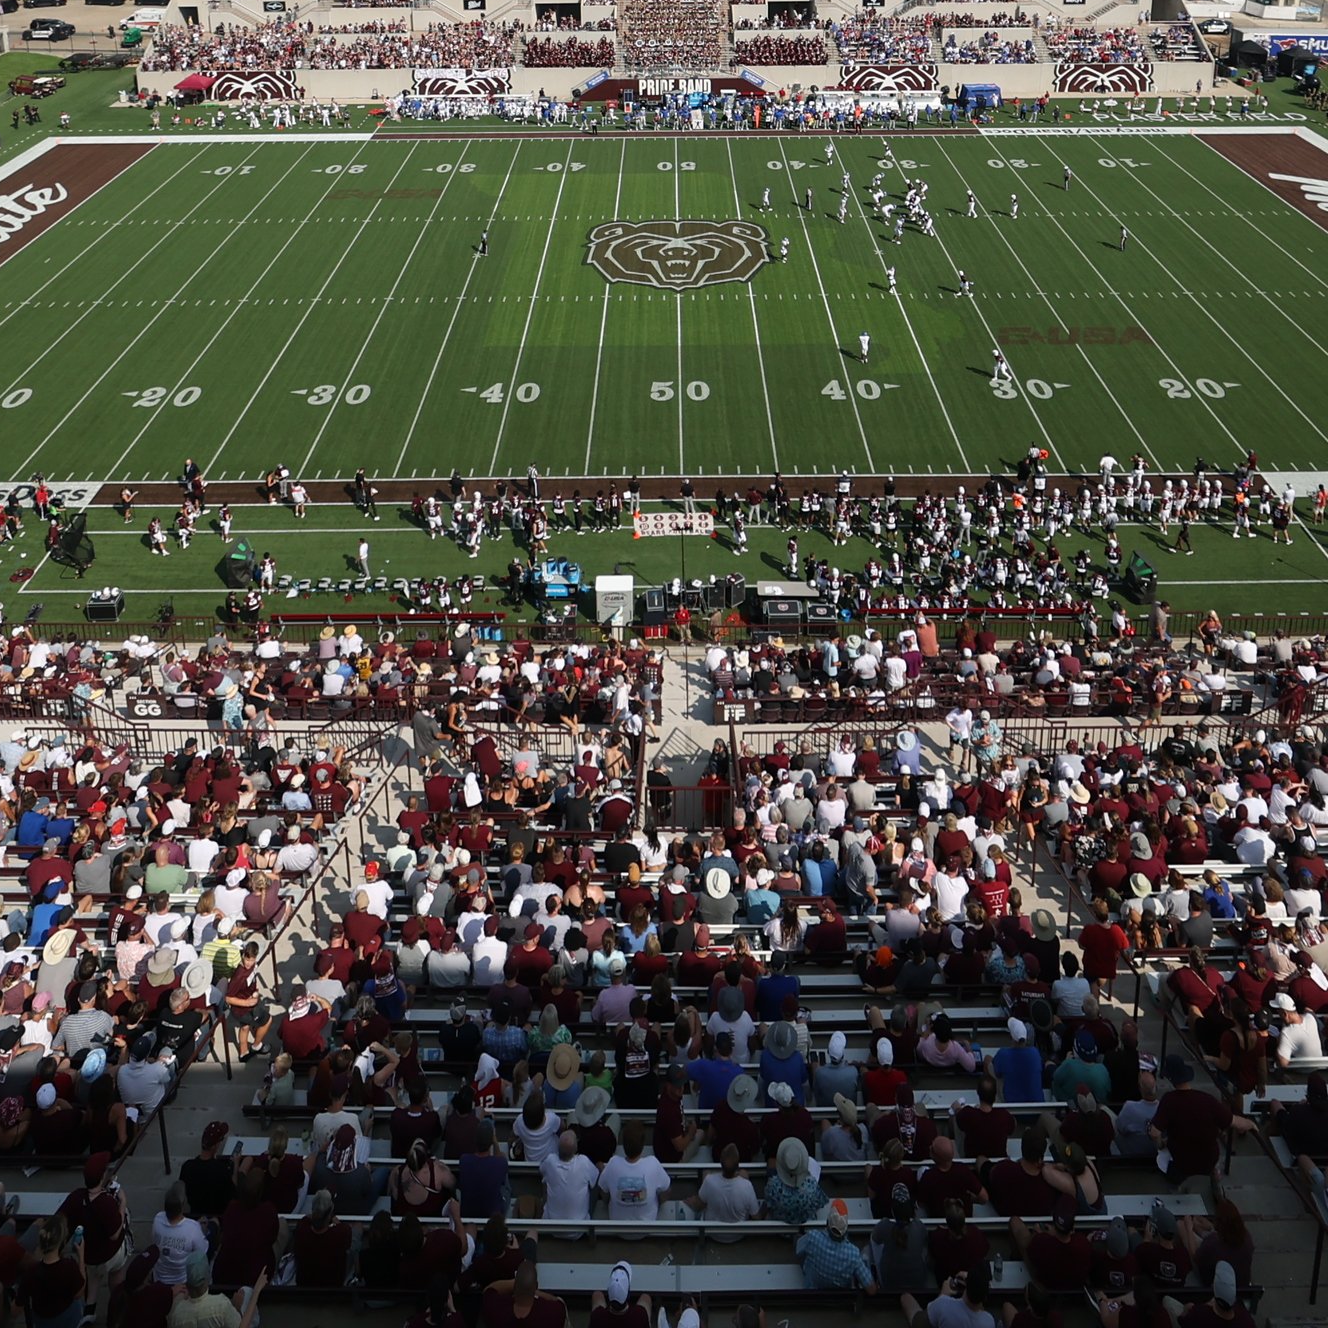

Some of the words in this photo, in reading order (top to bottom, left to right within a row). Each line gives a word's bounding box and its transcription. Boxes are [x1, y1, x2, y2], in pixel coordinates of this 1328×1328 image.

[638, 79, 675, 96] PRIDE
[679, 79, 712, 95] BAND
[1092, 112, 1220, 123] PLASTER
[1227, 112, 1307, 122] FIELD
[134, 386, 202, 408] 20
[306, 384, 372, 406] 30
[479, 382, 541, 404] 40
[650, 381, 711, 402] 50
[821, 379, 883, 400] 40
[989, 378, 1054, 400] 30
[1159, 378, 1226, 399] 20
[134, 704, 162, 717] GG
[723, 708, 746, 722] FF
[1221, 699, 1243, 712] FF
[479, 1094, 495, 1108] 12
